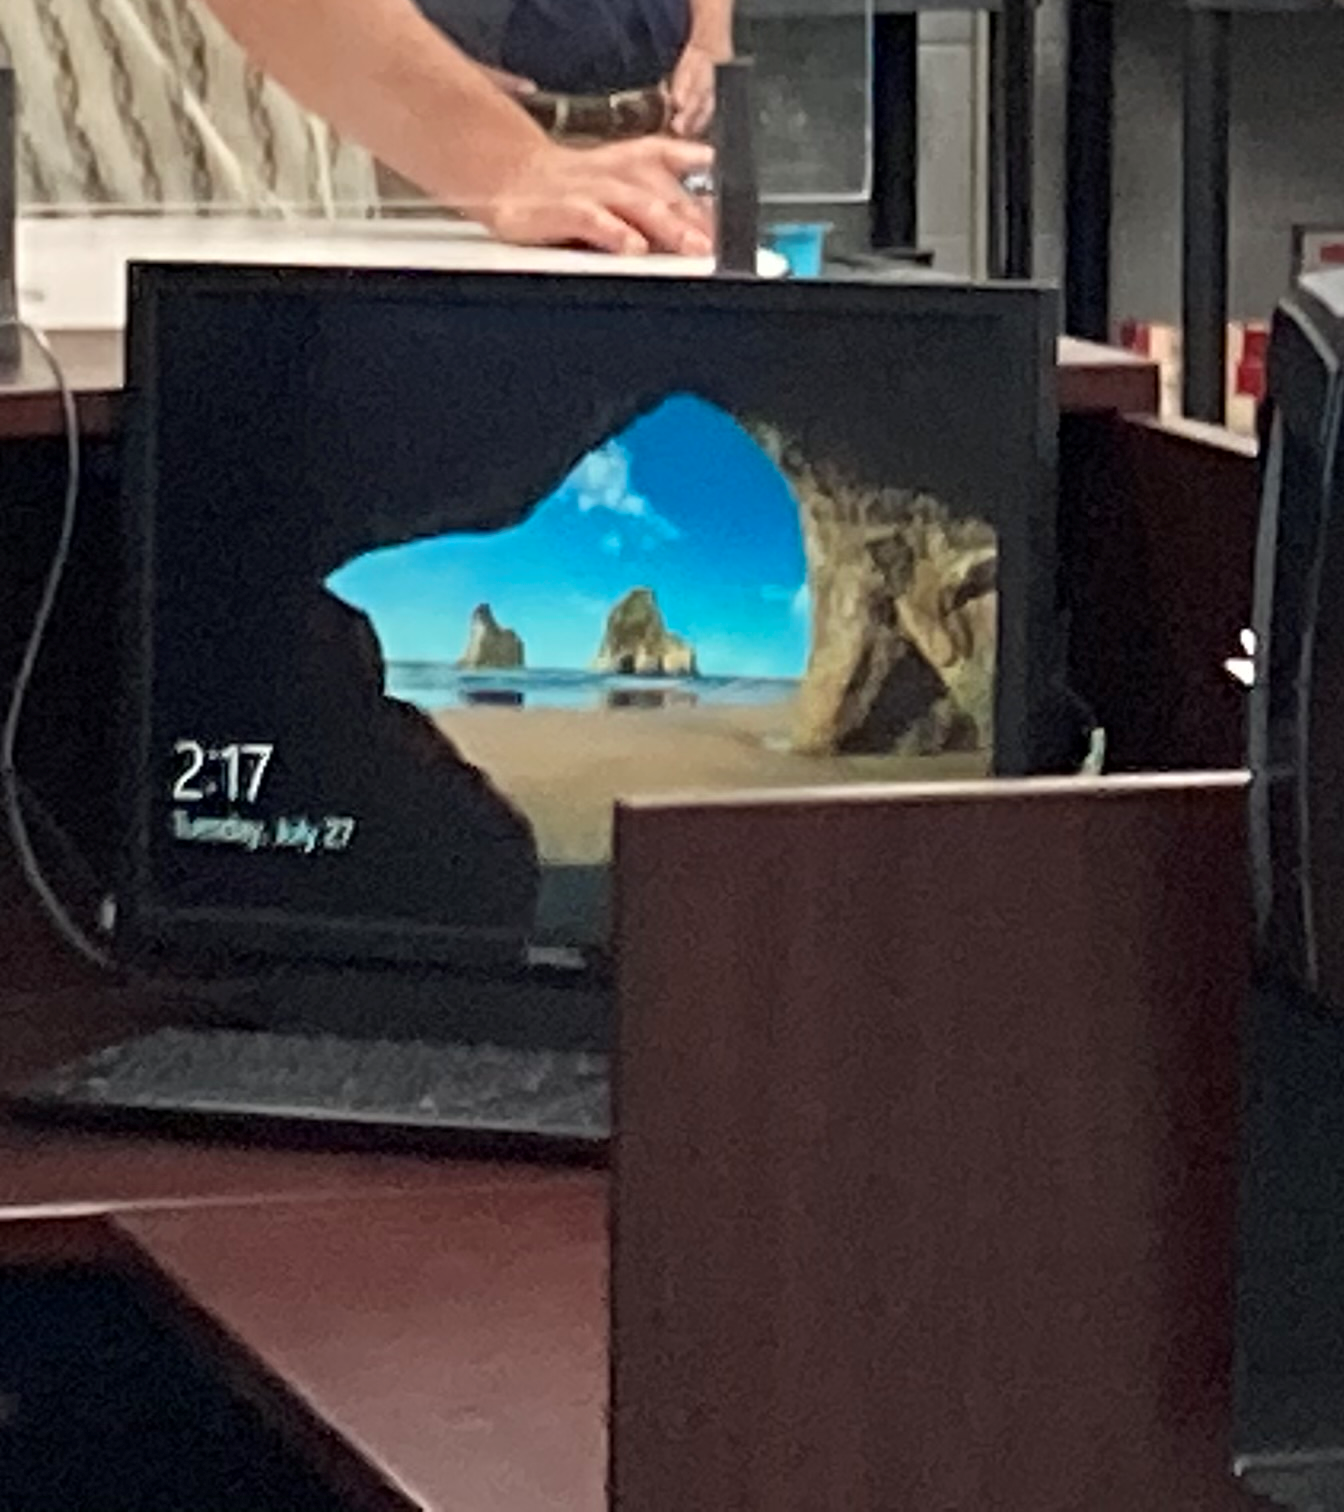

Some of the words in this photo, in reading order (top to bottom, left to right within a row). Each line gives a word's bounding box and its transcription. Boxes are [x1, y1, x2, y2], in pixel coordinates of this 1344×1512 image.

[172, 740, 274, 802] 2:17
[275, 816, 318, 853] July
[322, 816, 355, 850] 27
